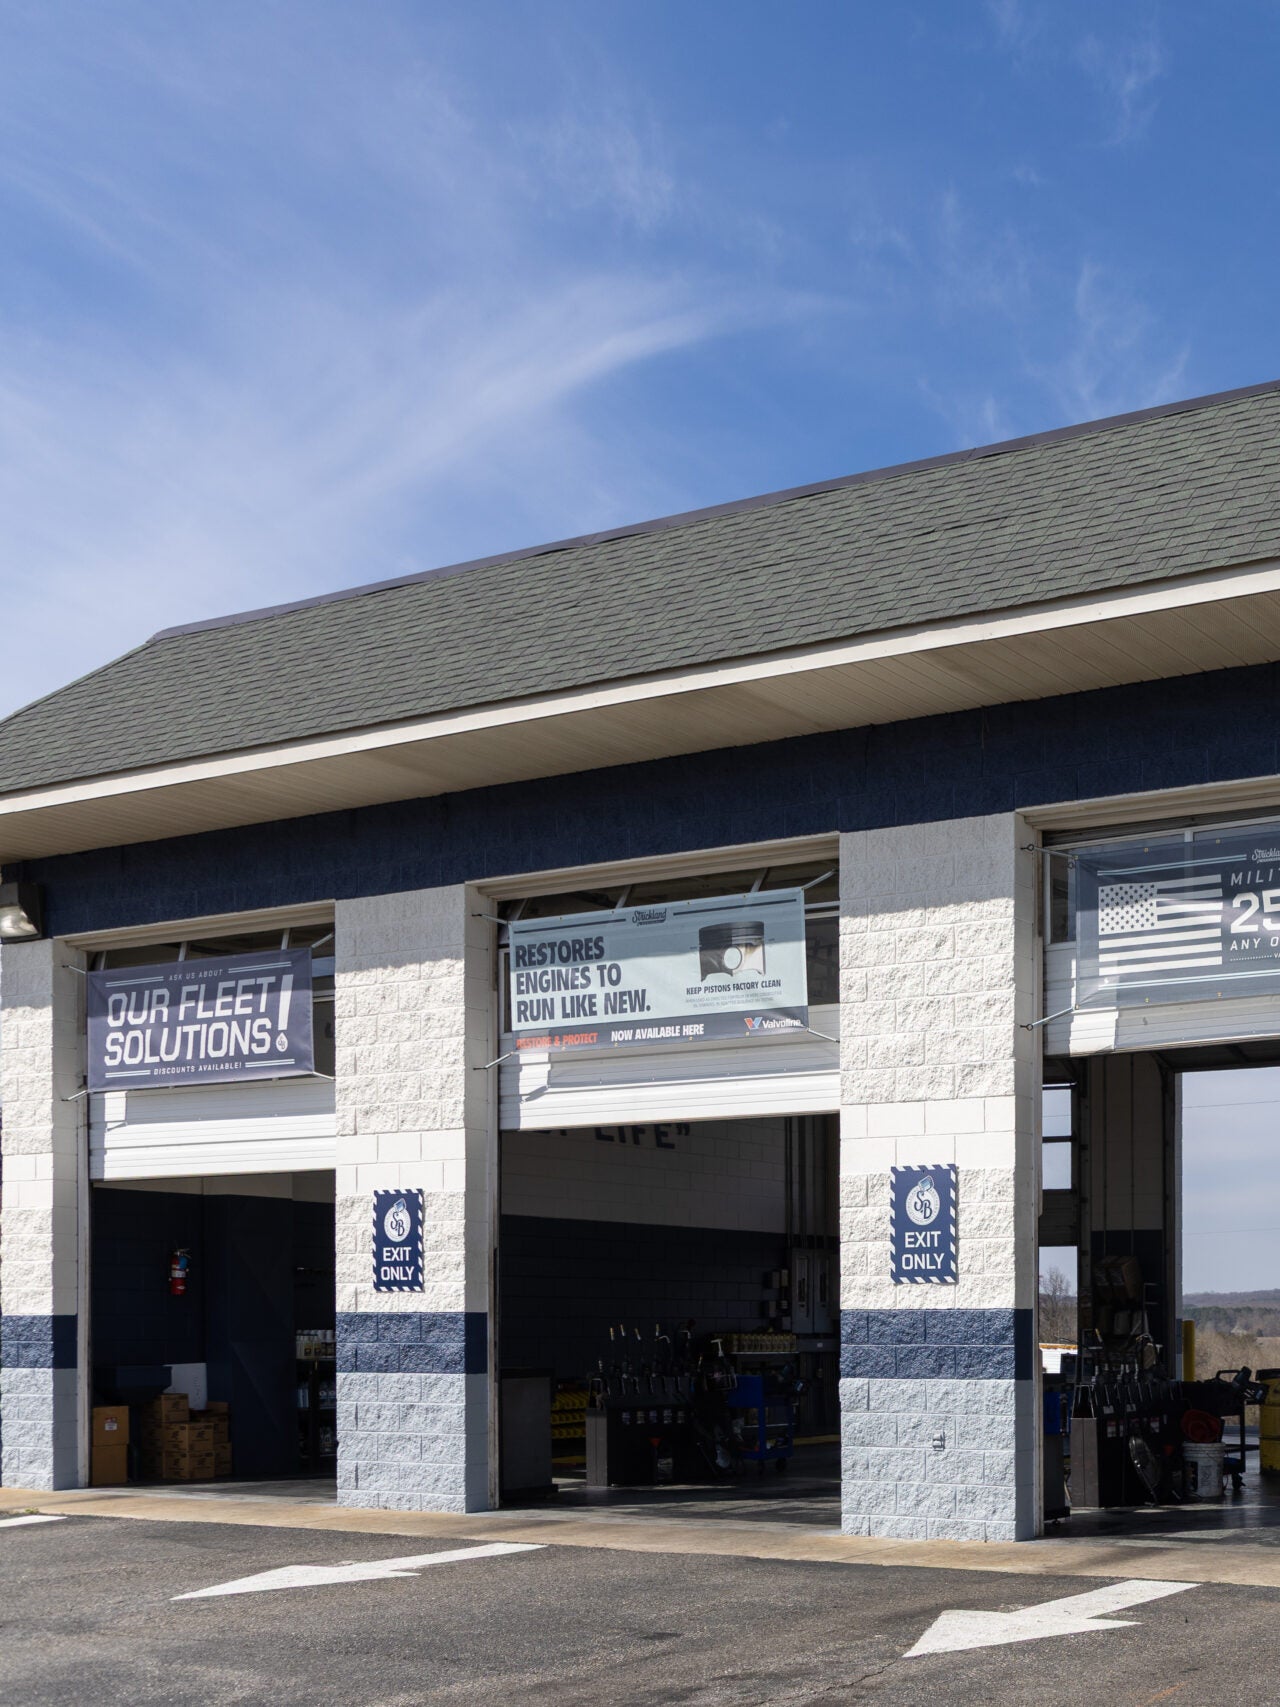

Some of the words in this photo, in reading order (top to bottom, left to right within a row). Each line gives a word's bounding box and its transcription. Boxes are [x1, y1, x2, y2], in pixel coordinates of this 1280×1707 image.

[632, 908, 667, 923] Strickland
[515, 936, 605, 968] RESTORES
[1230, 938, 1261, 951] ANY
[199, 969, 222, 978] ABOUT
[516, 966, 591, 995] ENGINES
[597, 963, 622, 987] TO
[686, 987, 702, 995] KEEP
[704, 984, 731, 993] PISTONS
[733, 981, 759, 991] FACTORY
[761, 979, 781, 989] CLEAN
[107, 988, 170, 1027] OUR
[178, 976, 276, 1021] FLEET
[517, 997, 555, 1023] RUN
[561, 994, 597, 1018] LIKE
[604, 989, 651, 1015] NEW.
[516, 1036, 551, 1050] RESTORE
[554, 1035, 560, 1045] &
[562, 1032, 598, 1046] PROTECT
[611, 1030, 633, 1042] NOW
[635, 1026, 680, 1040] AVAILABLE
[682, 1023, 704, 1036] HERE
[153, 1066, 195, 1075] DISCOUNTS
[198, 1062, 242, 1072] AVAILABLE!
[904, 1231, 941, 1248] EXIT
[382, 1247, 412, 1261] EXIT
[901, 1253, 945, 1270] ONLY
[380, 1266, 415, 1280] ONLY
